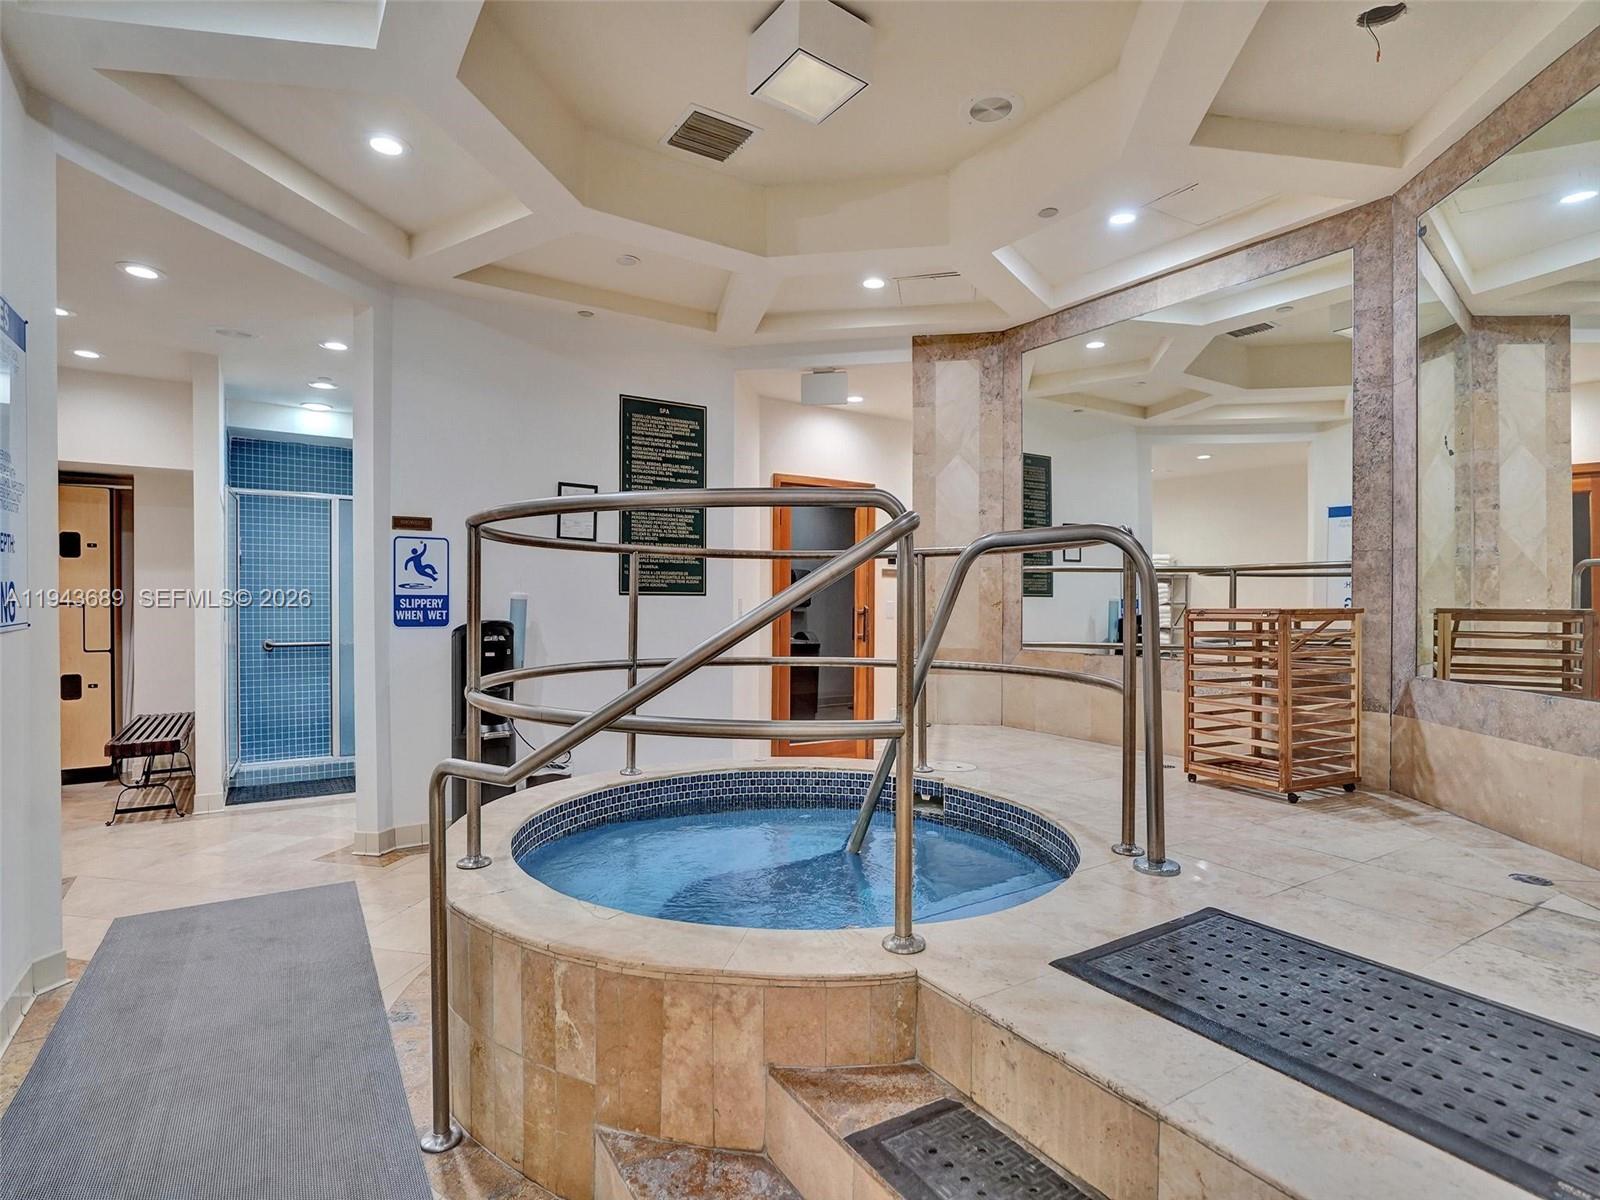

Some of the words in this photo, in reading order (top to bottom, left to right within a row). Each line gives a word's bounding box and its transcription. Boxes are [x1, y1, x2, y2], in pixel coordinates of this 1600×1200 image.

[400, 598, 444, 609] SLIPPERY
[396, 610, 423, 621] WHEN
[428, 610, 448, 620] WET
